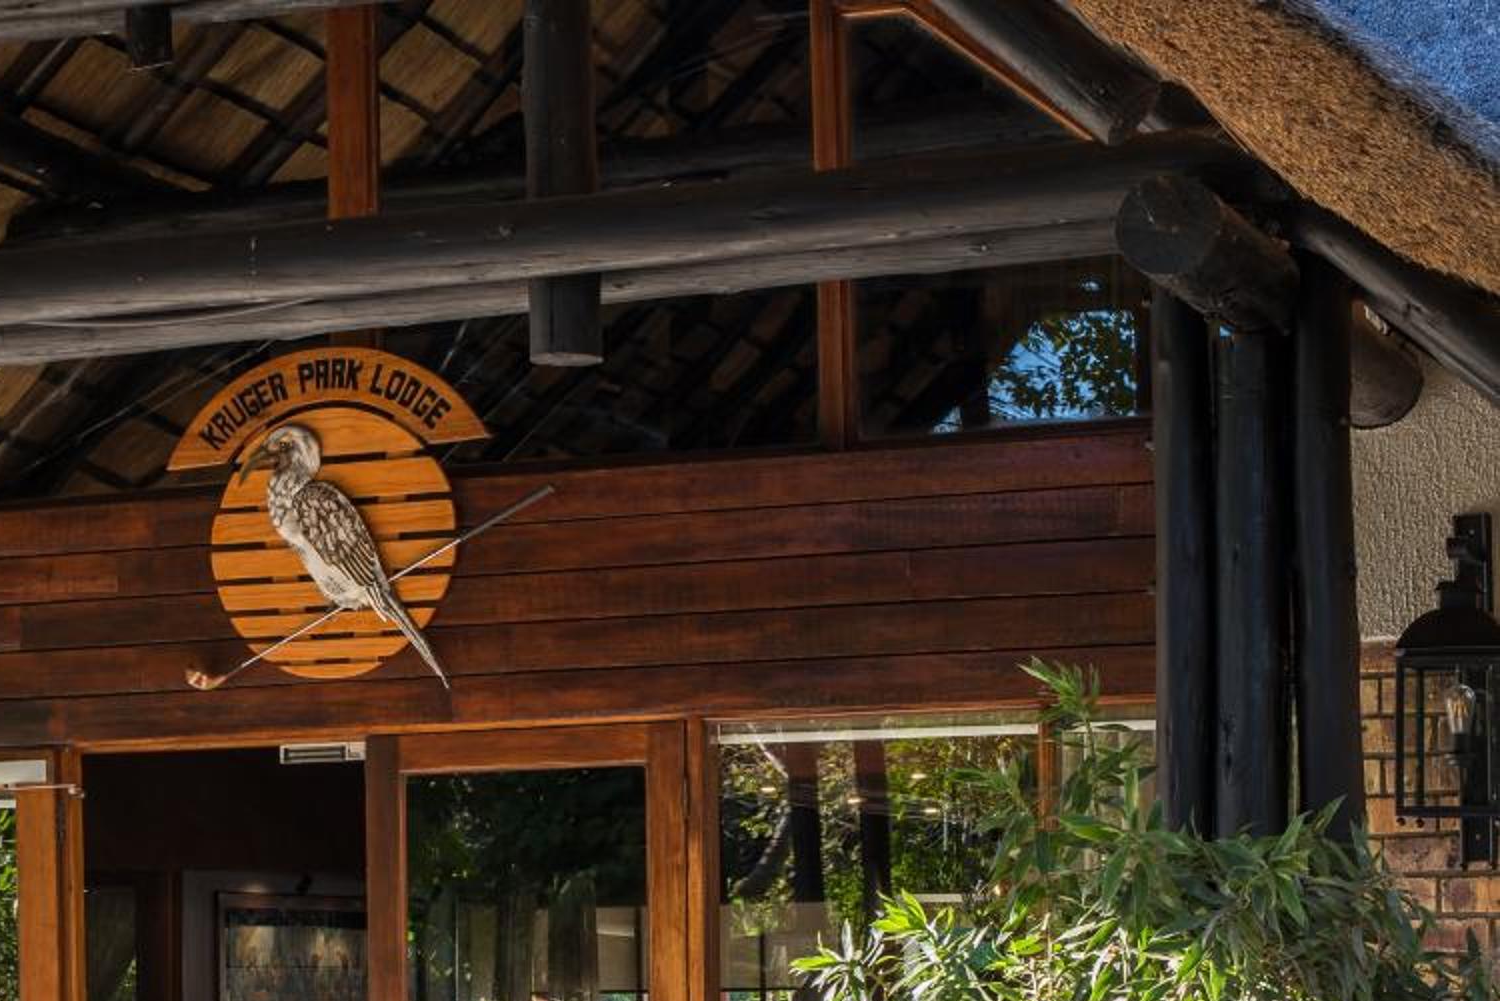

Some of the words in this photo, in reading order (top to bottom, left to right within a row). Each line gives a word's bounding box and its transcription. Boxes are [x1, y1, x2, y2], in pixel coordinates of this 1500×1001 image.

[199, 372, 289, 450] KRUGER
[297, 357, 364, 394] PARK
[369, 364, 452, 430] LODGE
